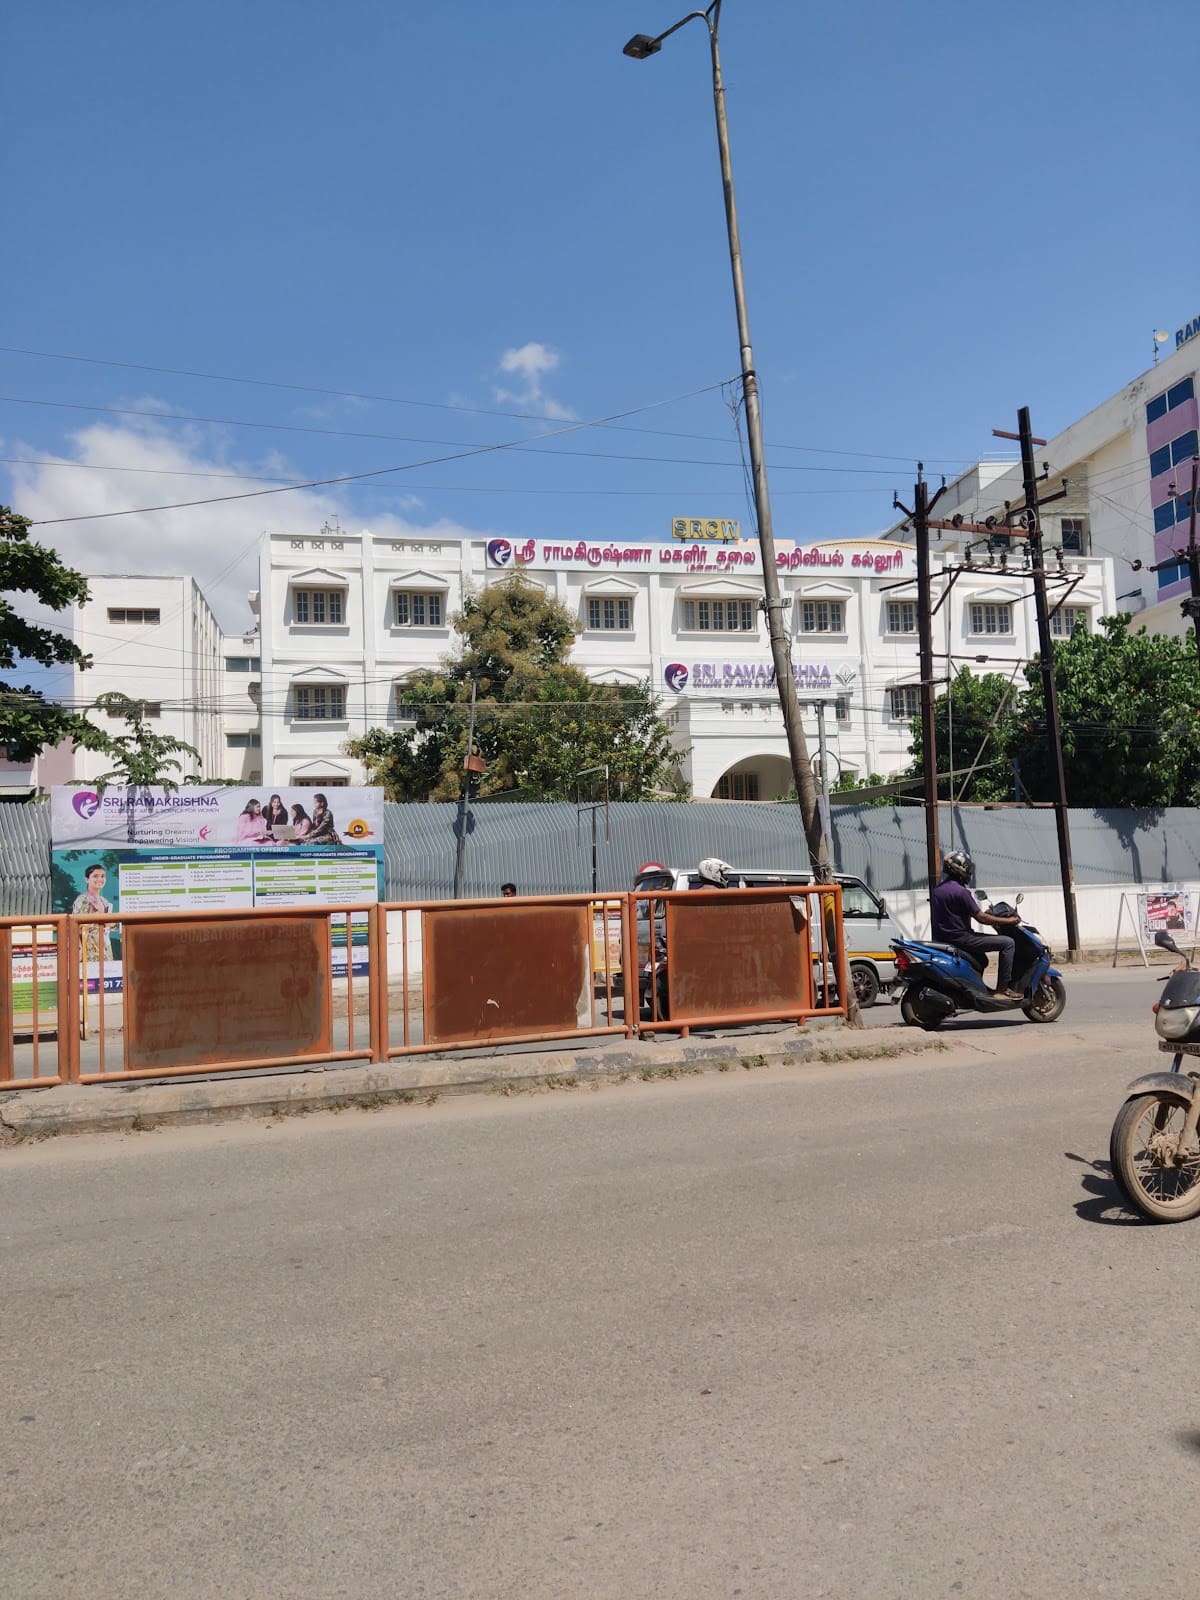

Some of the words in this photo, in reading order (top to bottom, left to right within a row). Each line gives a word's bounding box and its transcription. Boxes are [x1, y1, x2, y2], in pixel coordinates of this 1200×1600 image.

[675, 519, 737, 538] SRCW
[543, 541, 652, 567] ராமகிருஷ்ணா
[659, 544, 708, 565] மகளிர்
[716, 550, 756, 566] கலை
[775, 547, 844, 571] அறிவியல்
[852, 550, 903, 573] கல்லூரி
[692, 663, 716, 678] SRI
[723, 663, 832, 679] RAMAKSHNA
[103, 797, 122, 806] SRI
[127, 796, 219, 807] RAMAKRISHNA
[128, 829, 163, 837] Nurturing
